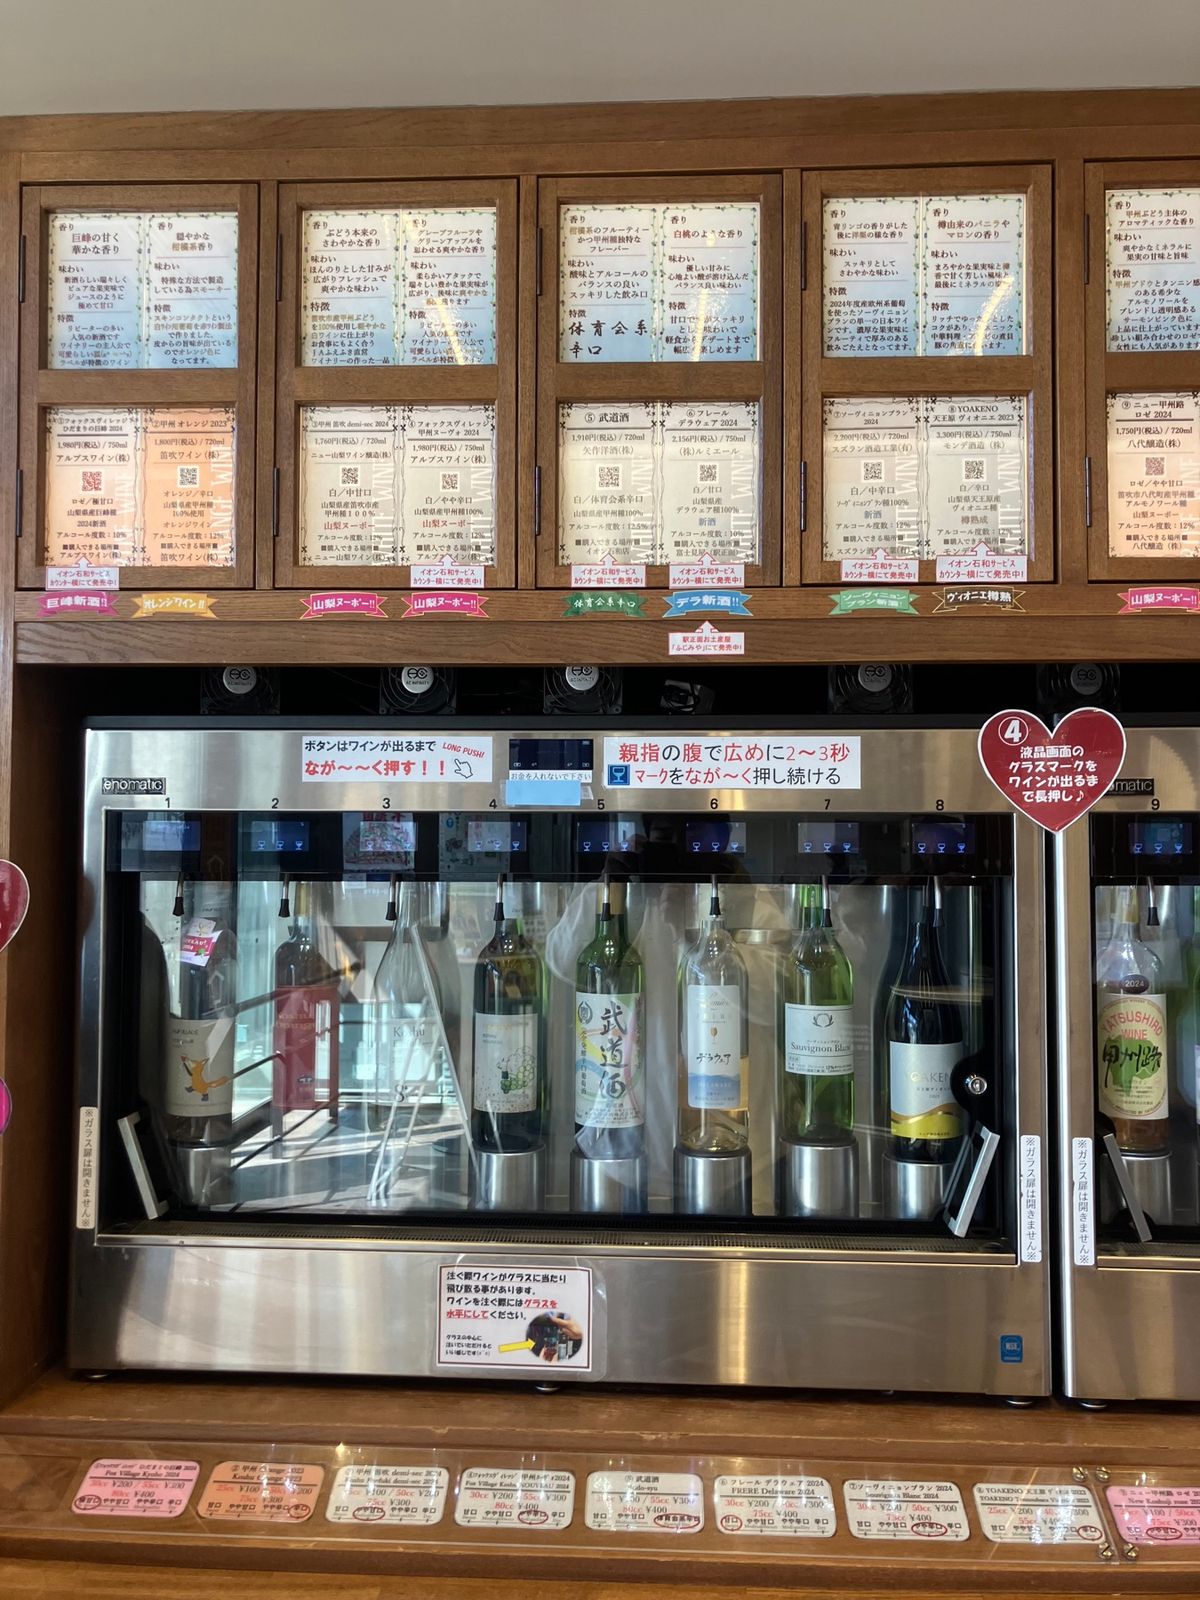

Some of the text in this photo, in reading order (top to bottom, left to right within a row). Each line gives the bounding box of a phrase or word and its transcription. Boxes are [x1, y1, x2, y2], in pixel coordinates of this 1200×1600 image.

[1115, 201, 1131, 209] 香り
[831, 210, 847, 218] 香り
[933, 208, 949, 217] 香り
[1126, 209, 1187, 218] 甲州ぶどう主体の
[570, 216, 585, 224] 香り
[670, 216, 687, 224] 香り
[1119, 218, 1195, 226] アロマティックな香り
[59, 223, 74, 231] 香り
[158, 222, 173, 231] 香り
[313, 221, 328, 229] 香り
[176, 233, 210, 241] 穏やかな
[326, 229, 377, 237] ぶどう本来の
[1114, 233, 1141, 241] 味わい
[72, 233, 119, 243] 巨峰の甘く
[323, 239, 380, 247] さわやかな香り
[830, 249, 856, 257] 味わい
[931, 250, 958, 259] 味わい
[669, 255, 695, 263] 味わい
[154, 263, 180, 271] 味わい
[844, 260, 896, 268] スッキリとして
[59, 265, 84, 273] 味わい
[310, 264, 391, 273] ほんのりとした甘みが
[416, 272, 481, 280] 柔らかいアタックで
[570, 270, 648, 278] 酸味とアルコールの
[668, 273, 749, 281] 心地よい酸が溶け込んだ
[839, 269, 899, 277] さわやかな味わい
[1113, 270, 1131, 278] 特徴
[161, 276, 224, 284] 特殊な方法で製造
[314, 275, 387, 283] 広がりフレッシュで
[578, 280, 640, 288] バランスの良い
[321, 285, 379, 293] 爽やかな味わい
[829, 287, 847, 296] 特徴
[570, 290, 648, 299] スッキリした飲み口
[154, 304, 171, 312] 特徴
[310, 302, 330, 311] 特徴
[669, 302, 686, 310] 特徴
[931, 303, 950, 311] 特徴
[409, 311, 426, 320] 特徴
[568, 309, 586, 318] 特徴
[57, 314, 74, 323] 特徴
[958, 405, 998, 413] YOAKENO
[599, 412, 629, 423] 武道酒
[959, 414, 996, 422] ヴィオニエ
[1154, 410, 1172, 418] 2024
[179, 420, 209, 428] オレンジ
[347, 420, 373, 428] demi-sec
[678, 419, 718, 427] デラウェア
[624, 433, 645, 441] 720ml
[888, 432, 909, 440] 720ml
[991, 430, 1012, 438] 750ml
[367, 437, 387, 445] 720ml
[864, 510, 882, 519] 新酒
[699, 517, 716, 526] 新酒
[852, 562, 910, 570] イオン石和サービス
[947, 559, 1016, 568] イオン石和サービス
[581, 567, 637, 575] イオン石和サービス
[679, 567, 735, 575] イオン石和サービス
[947, 591, 1013, 603] ヴィオニエ樽熟
[1130, 594, 1198, 605] 山梨ヌーボー!!
[313, 598, 375, 610] 山梨ヌーボー!!
[414, 598, 476, 610] 山梨ヌーボー!!
[676, 595, 739, 608] デラ新酒!!
[305, 740, 436, 752] ボタンはワインが出るまで
[442, 742, 485, 758] LONG PUSH!
[1020, 746, 1084, 758] 液晶画面の
[1009, 761, 1097, 773] グラスマークを
[511, 771, 591, 780] お金を入れないで下さい
[103, 779, 163, 790] enomatic
[1009, 775, 1098, 787] ワインが出るま
[165, 798, 171, 808] 1
[272, 798, 279, 809] 2
[382, 798, 391, 809] 3
[489, 799, 497, 809] 4
[597, 799, 605, 810] 5
[710, 798, 718, 809] 6
[824, 799, 830, 809] 7
[936, 800, 944, 811] 8
[1151, 799, 1160, 810] 9
[1125, 980, 1144, 988] 2024
[1102, 1011, 1162, 1036] YATSUSHIRO
[1121, 1029, 1148, 1040] WINE
[600, 1000, 628, 1098] 武道酒
[791, 1042, 832, 1054] Sauvignon
[696, 1053, 731, 1065] デラウェア
[447, 1272, 566, 1283] 注ぐ際ワインがグラスに当たり
[447, 1284, 535, 1295] 飛び散る事があります。
[446, 1296, 558, 1308] ワインを注ぐ際にはグラスを
[446, 1309, 527, 1320] 水平にしてください。
[395, 1489, 415, 1497] 50cc
[470, 1491, 513, 1500] 30cc ¥200
[495, 1502, 514, 1510] 80cc
[935, 1504, 957, 1512] ¥300
[753, 1510, 773, 1518] 75cc
[909, 1513, 931, 1521] ¥400
